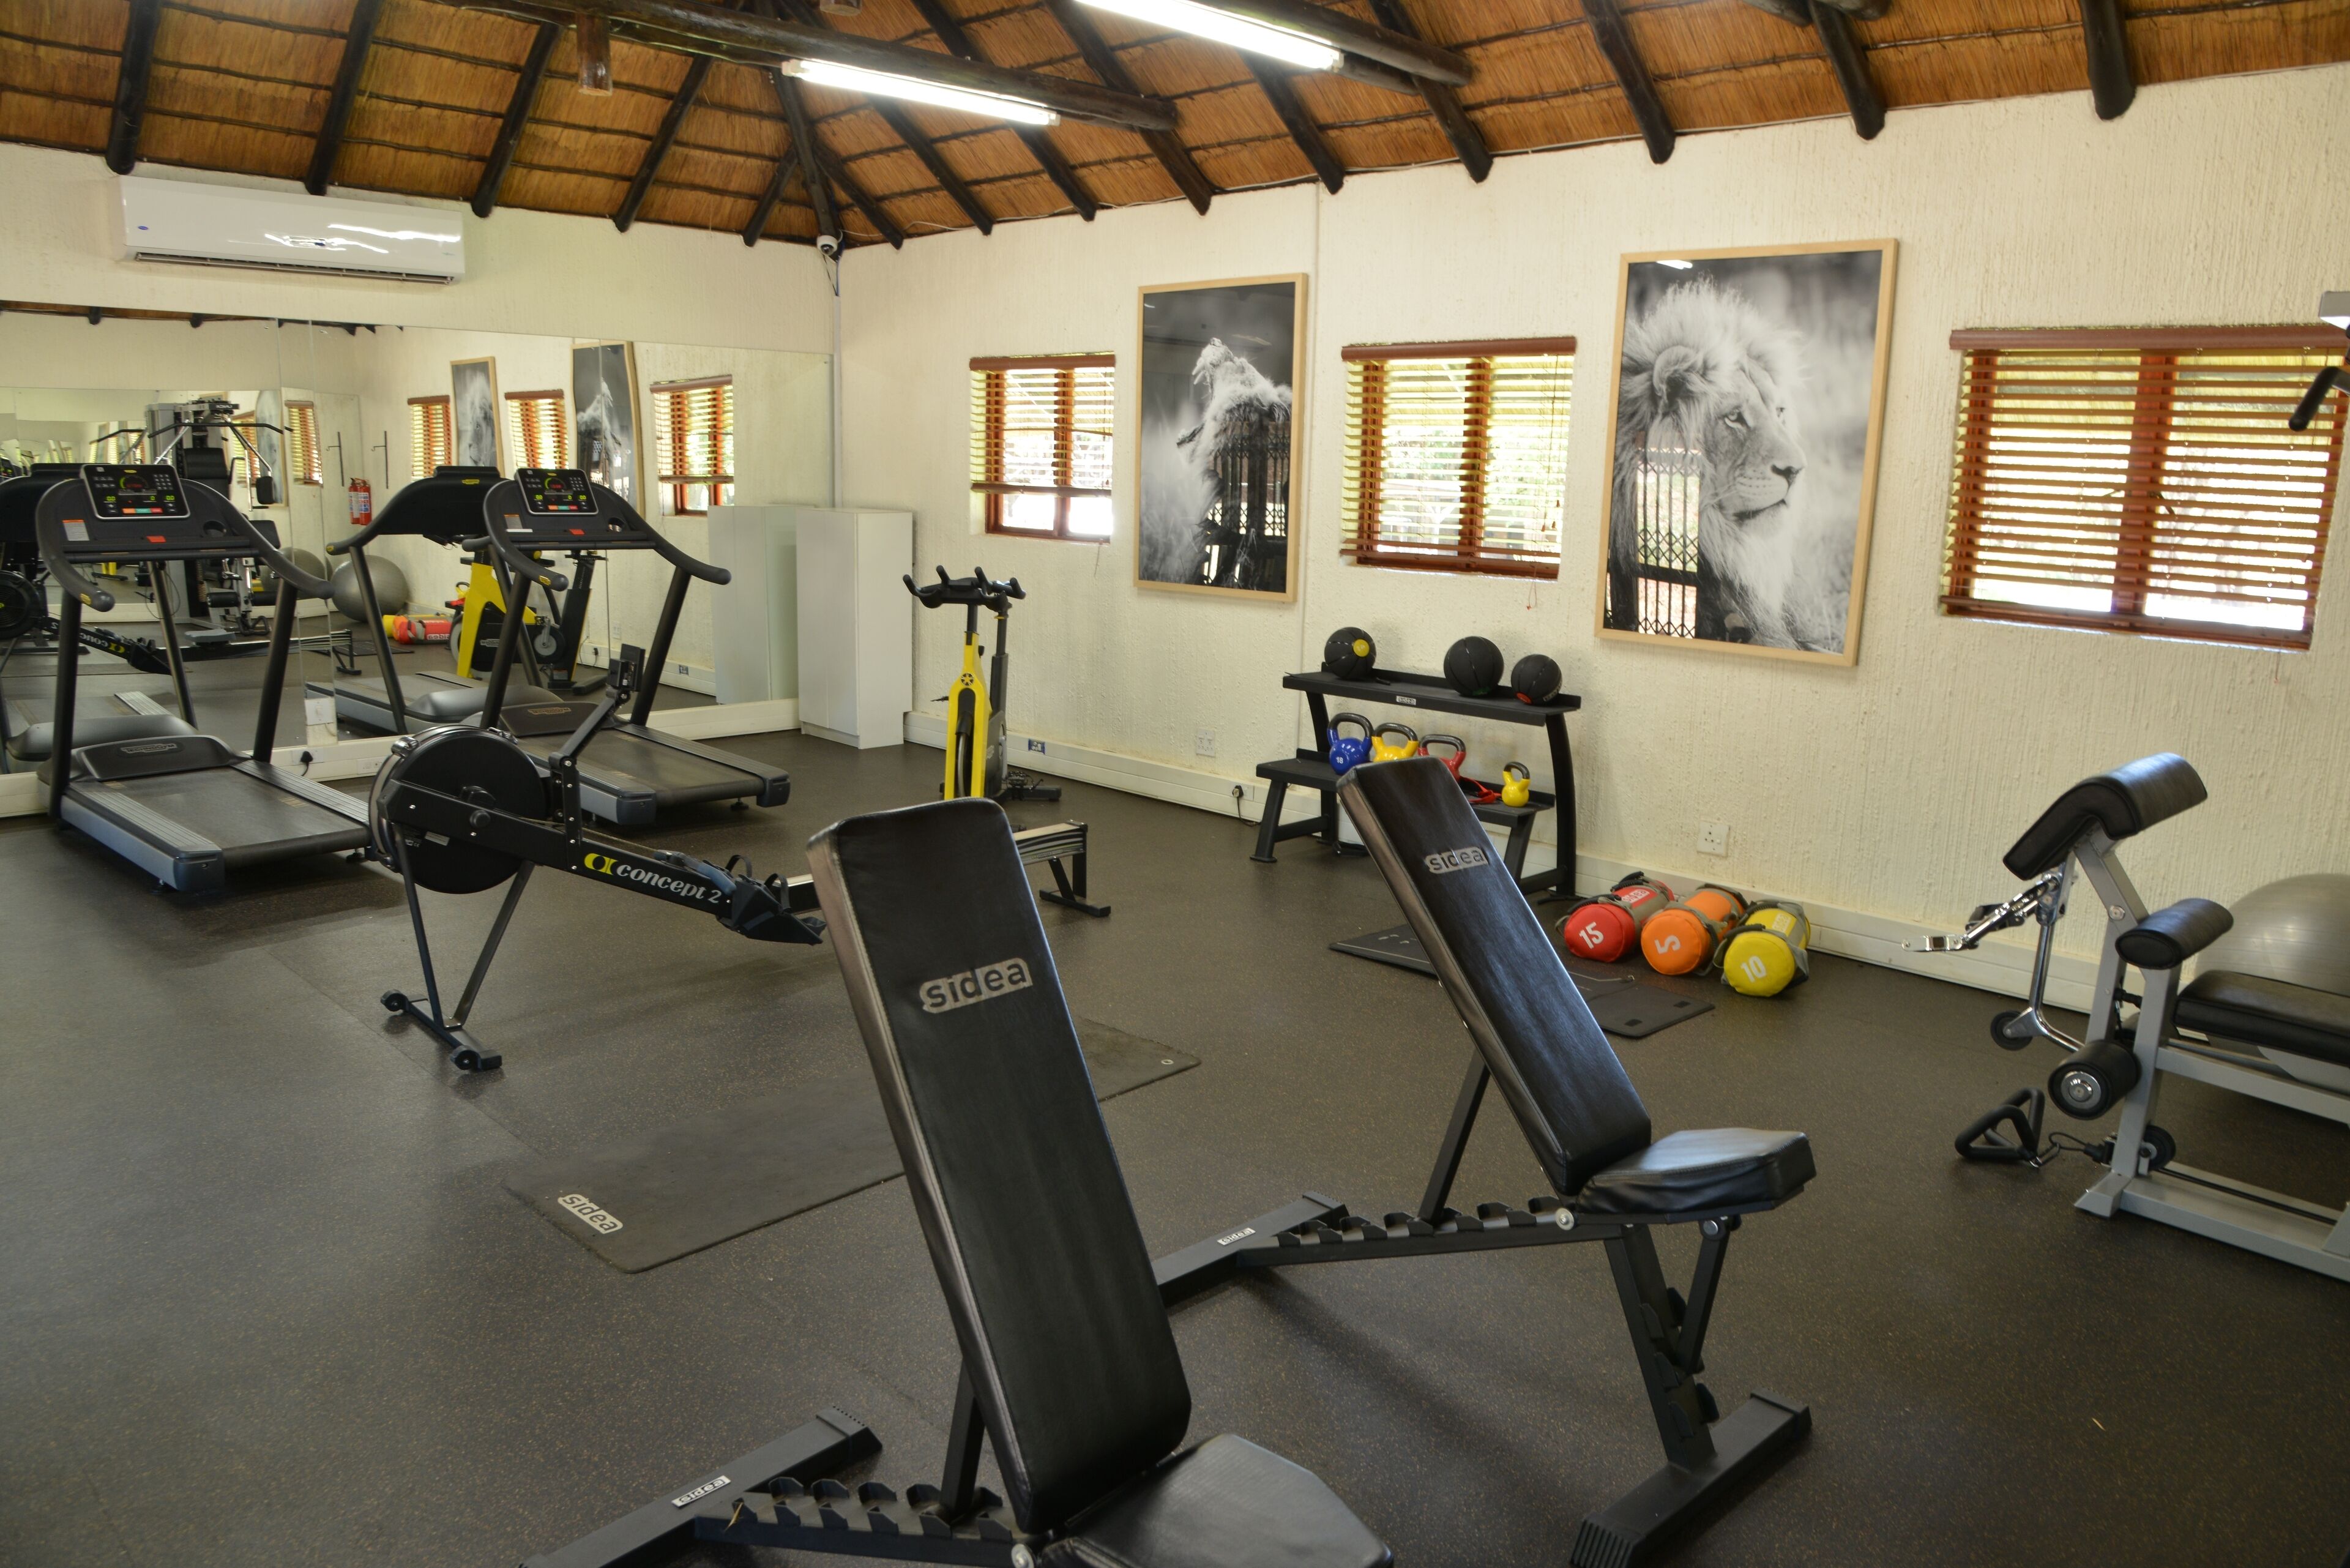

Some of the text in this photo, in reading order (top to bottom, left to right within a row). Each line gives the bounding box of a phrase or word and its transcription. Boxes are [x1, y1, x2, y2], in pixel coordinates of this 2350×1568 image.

[1430, 848, 1484, 871] sidea
[616, 864, 722, 903] concept 2
[1579, 922, 1604, 949] 15
[1655, 935, 1681, 954] 5
[1740, 955, 1767, 982] 10
[926, 963, 1027, 1008] sidea
[562, 1197, 618, 1231] sidea
[679, 1479, 725, 1504] sidea
